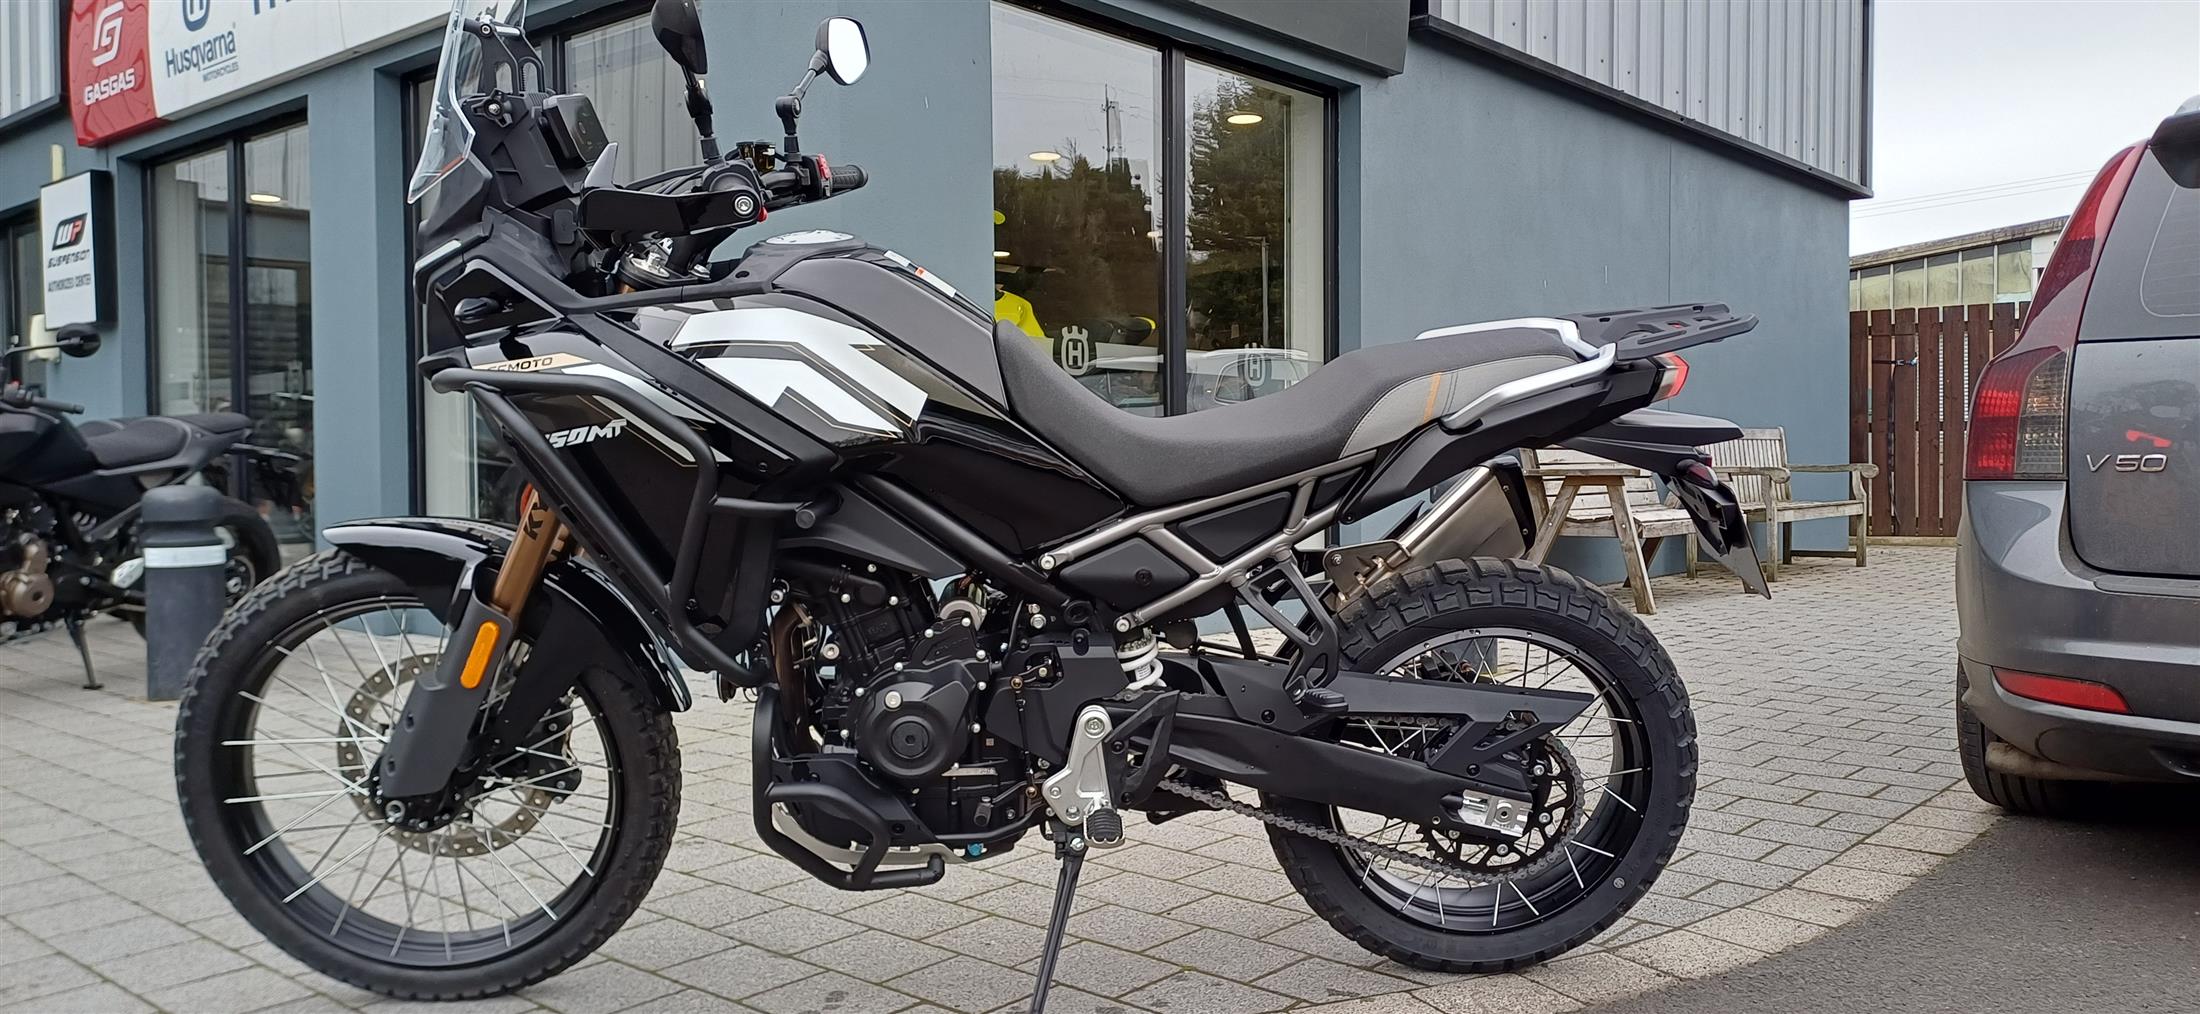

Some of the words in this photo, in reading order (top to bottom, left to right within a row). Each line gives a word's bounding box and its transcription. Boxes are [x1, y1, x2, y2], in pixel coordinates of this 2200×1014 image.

[165, 30, 237, 78] Husqvarna
[83, 68, 136, 106] GASGAS
[544, 418, 628, 449] 50MT
